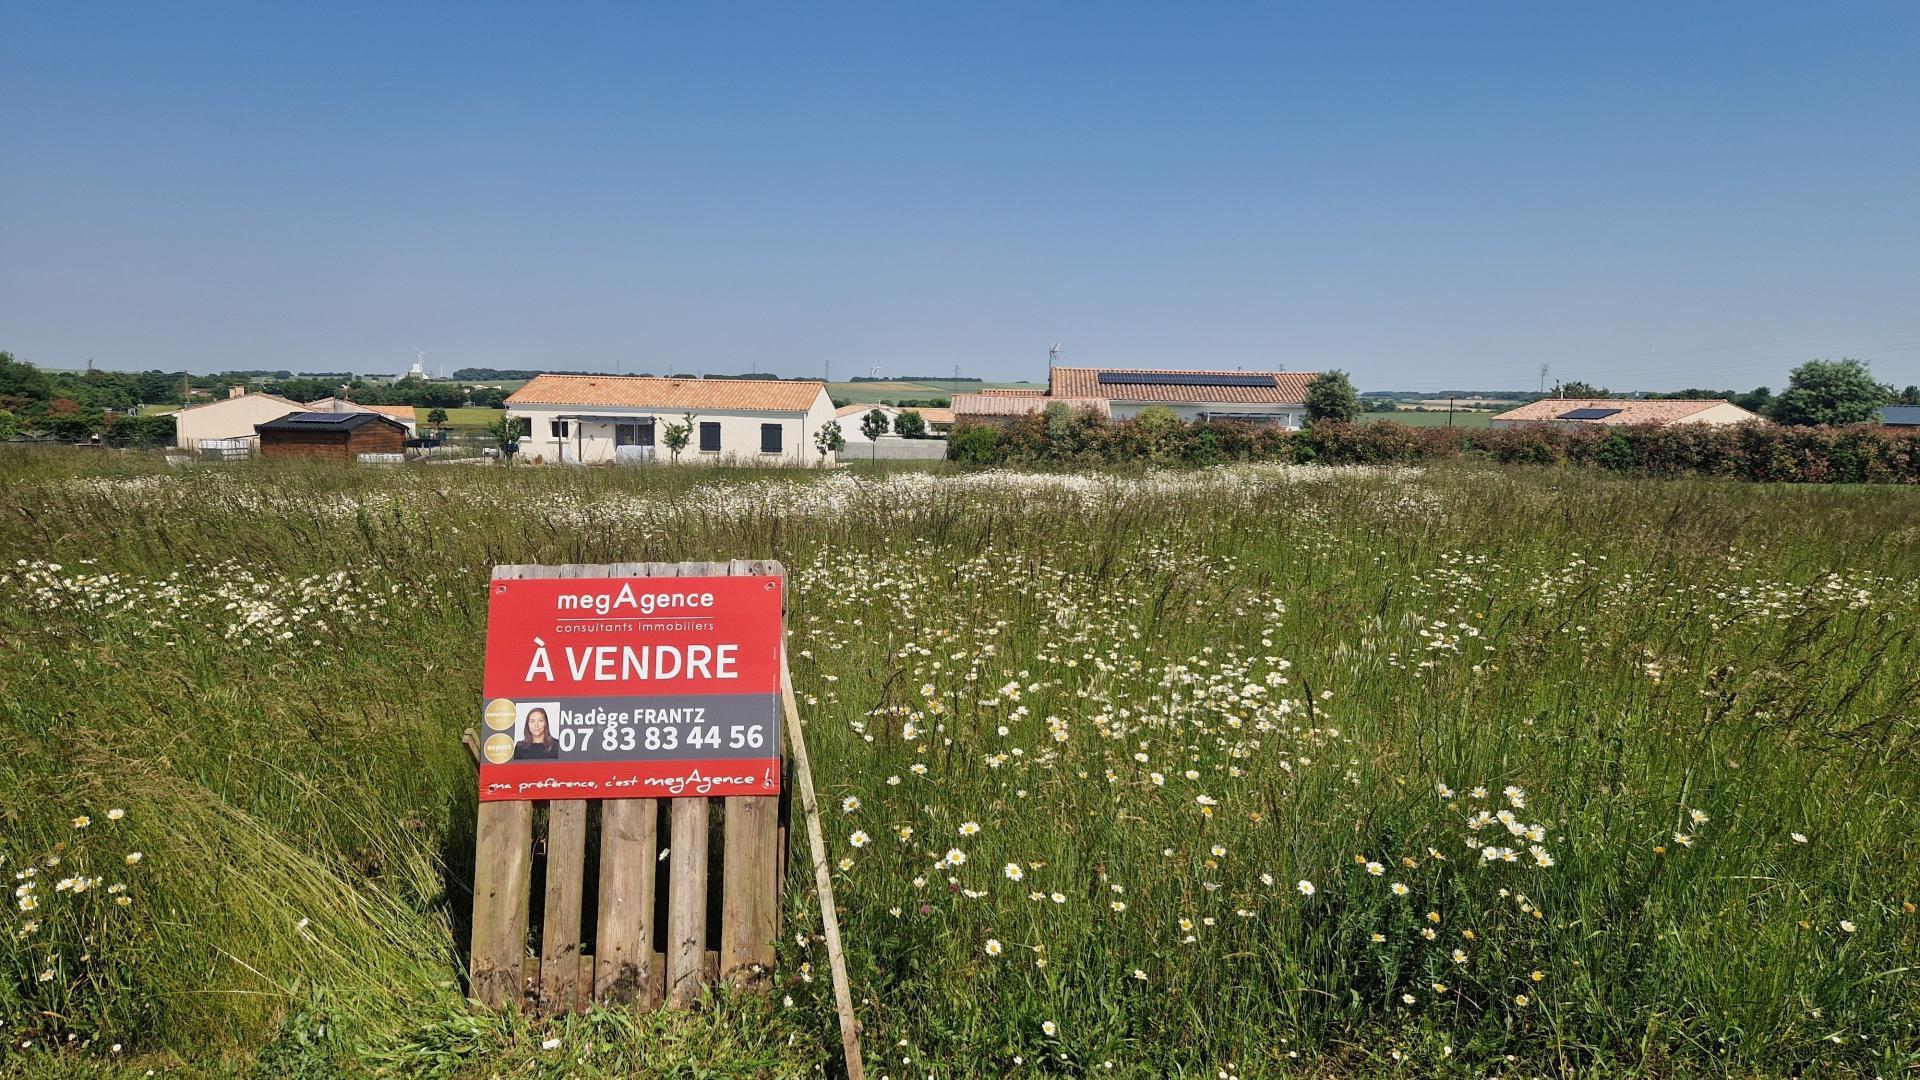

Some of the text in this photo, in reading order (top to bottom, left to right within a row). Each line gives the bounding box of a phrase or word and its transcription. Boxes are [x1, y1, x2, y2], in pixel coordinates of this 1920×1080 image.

[557, 582, 714, 615] megAgence
[556, 621, 714, 633] consultants immobiliers
[525, 637, 739, 681] À VENDRE
[560, 707, 705, 728] Nadège FRANTZ
[559, 725, 764, 751] 07 83 83 44 56
[605, 776, 638, 787] c'est
[644, 769, 755, 794] megAgence
